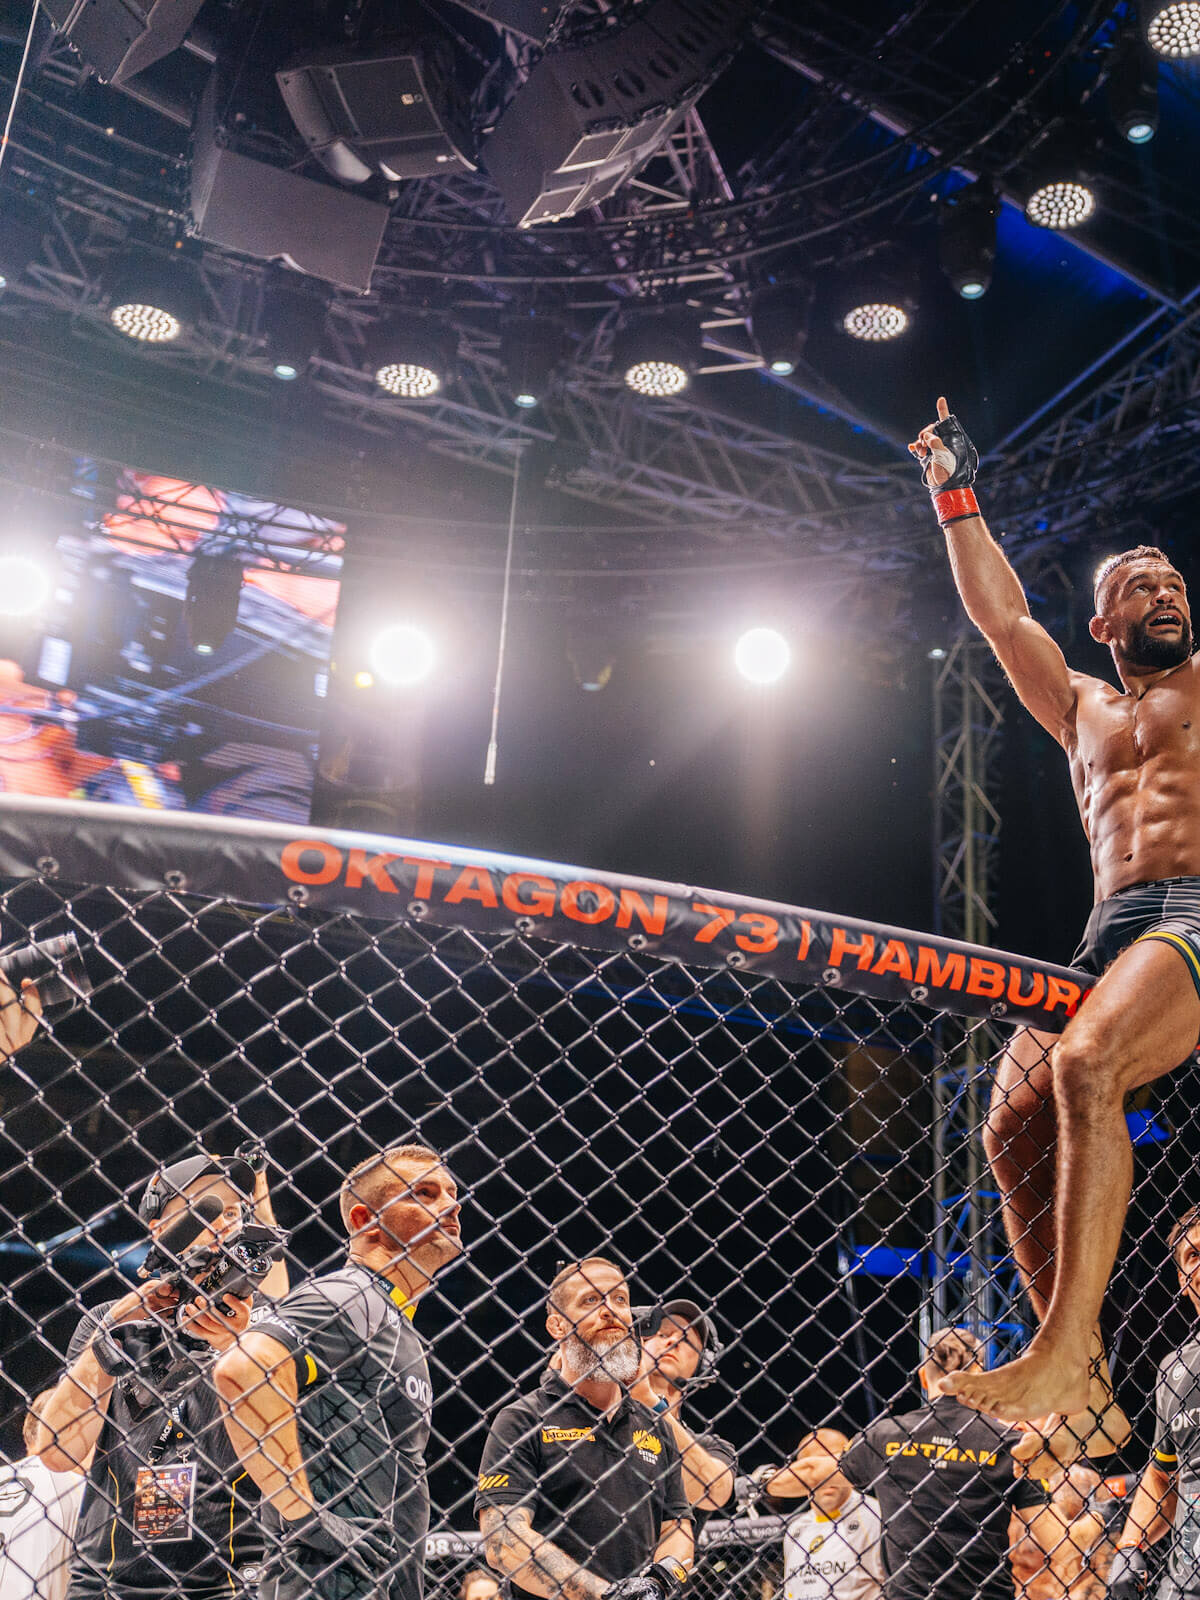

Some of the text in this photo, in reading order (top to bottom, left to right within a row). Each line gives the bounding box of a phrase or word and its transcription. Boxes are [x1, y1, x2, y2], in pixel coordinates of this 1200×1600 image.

[280, 840, 669, 935] OKTAGON
[692, 903, 780, 954] 73
[830, 928, 1098, 1018] HAMBUR
[885, 1441, 998, 1467] CUTMAN
